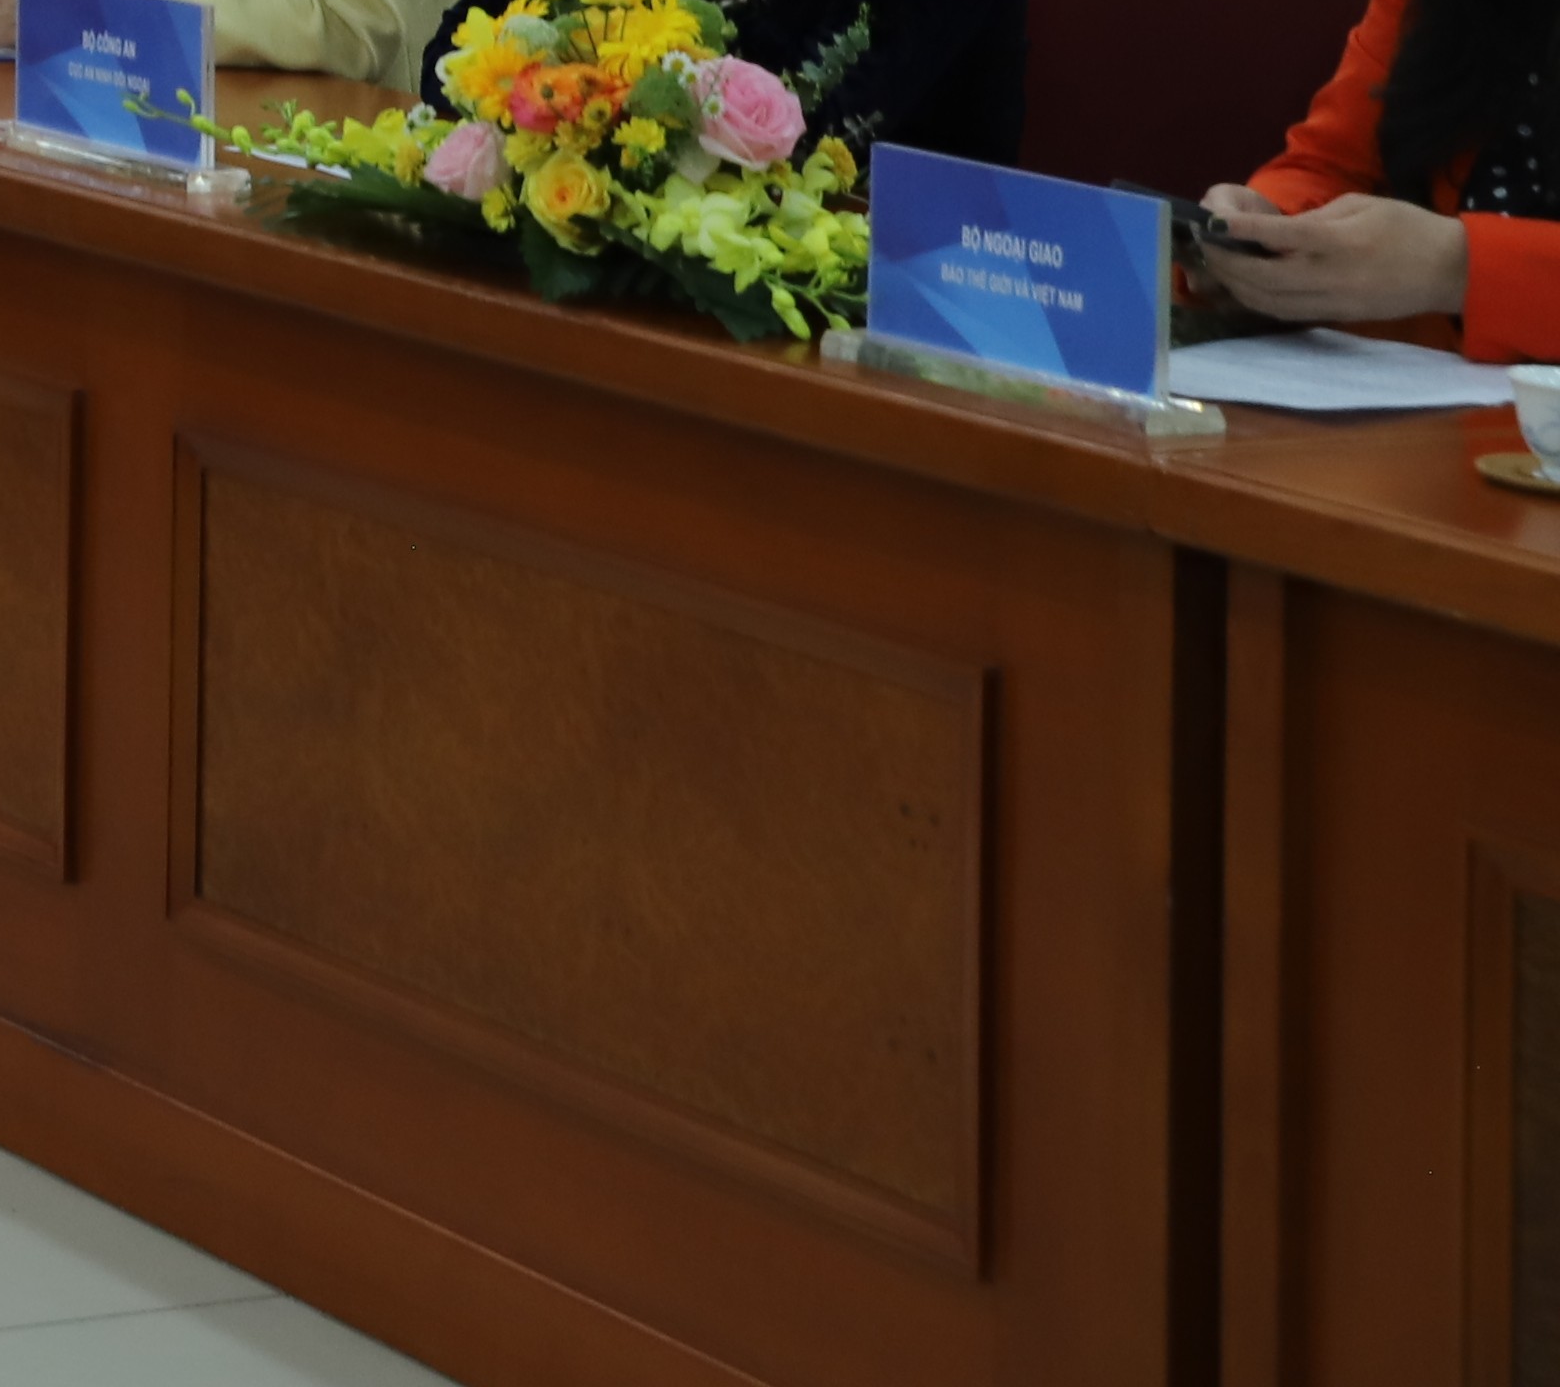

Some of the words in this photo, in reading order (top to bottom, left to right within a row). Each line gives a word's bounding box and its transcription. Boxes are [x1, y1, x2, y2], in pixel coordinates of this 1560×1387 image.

[123, 39, 137, 59] AN
[961, 224, 981, 255] BỘ
[983, 229, 1026, 264] NGOẠI
[1028, 239, 1064, 269] GIAO
[1057, 288, 1084, 313] NAM
